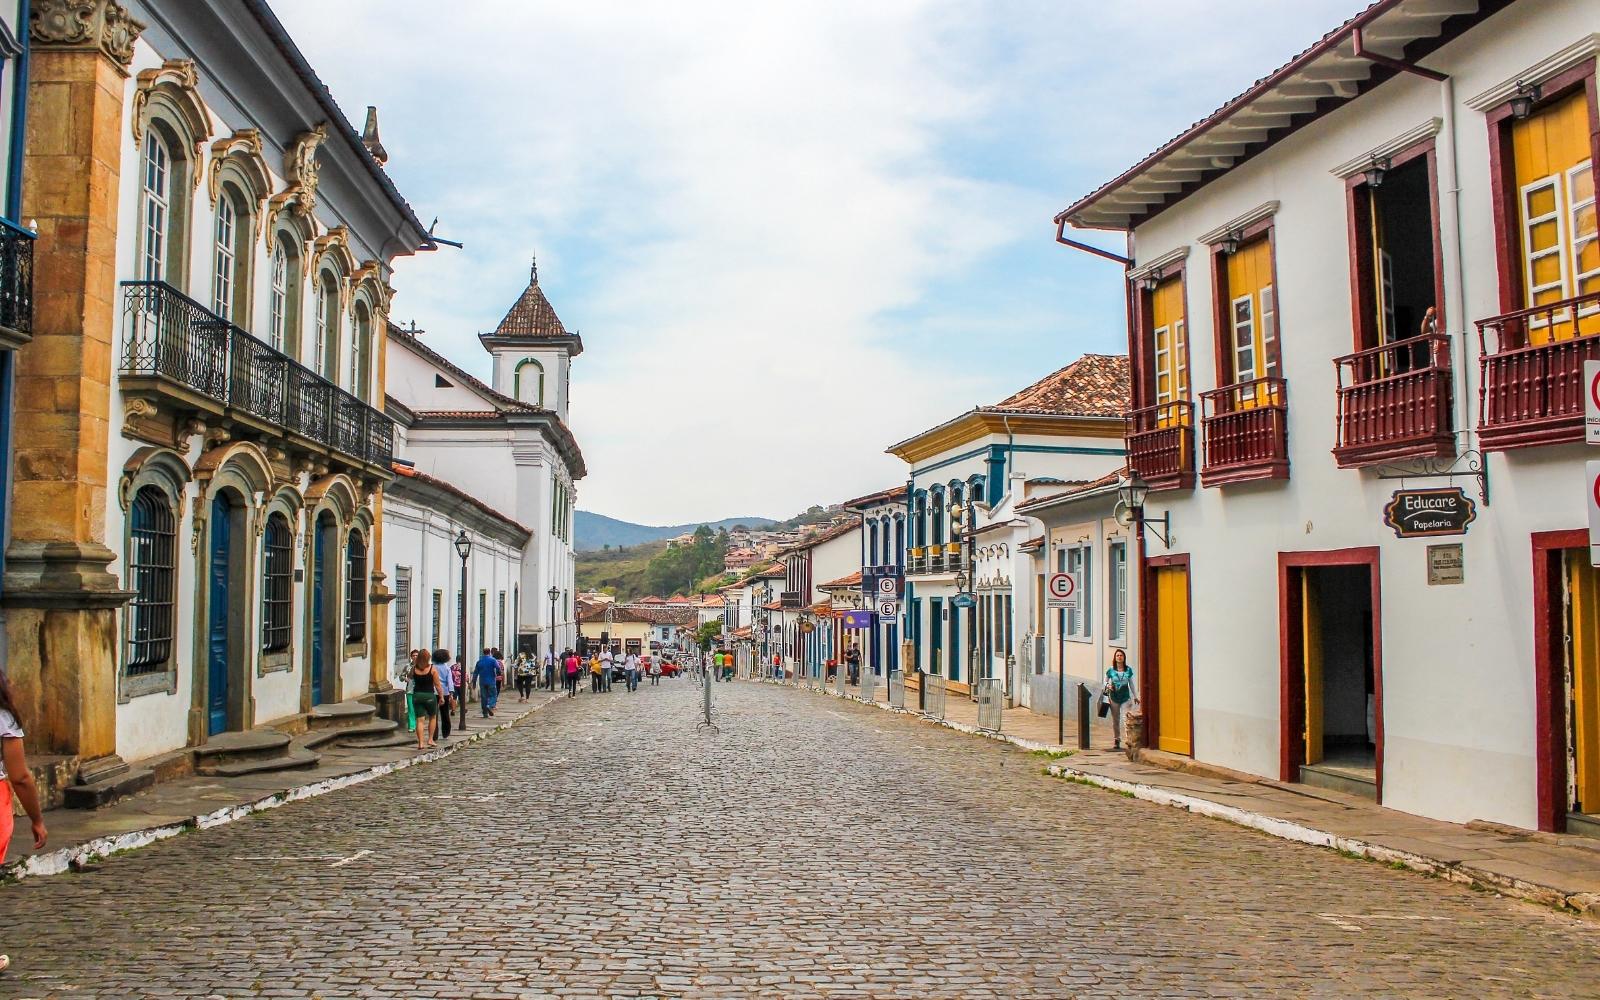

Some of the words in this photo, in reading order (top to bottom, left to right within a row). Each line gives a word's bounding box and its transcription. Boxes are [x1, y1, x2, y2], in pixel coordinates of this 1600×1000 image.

[1405, 495, 1457, 510] Educare
[1413, 519, 1452, 531] Papelaria
[884, 582, 890, 590] E
[1058, 579, 1066, 592] E
[884, 604, 891, 614] E
